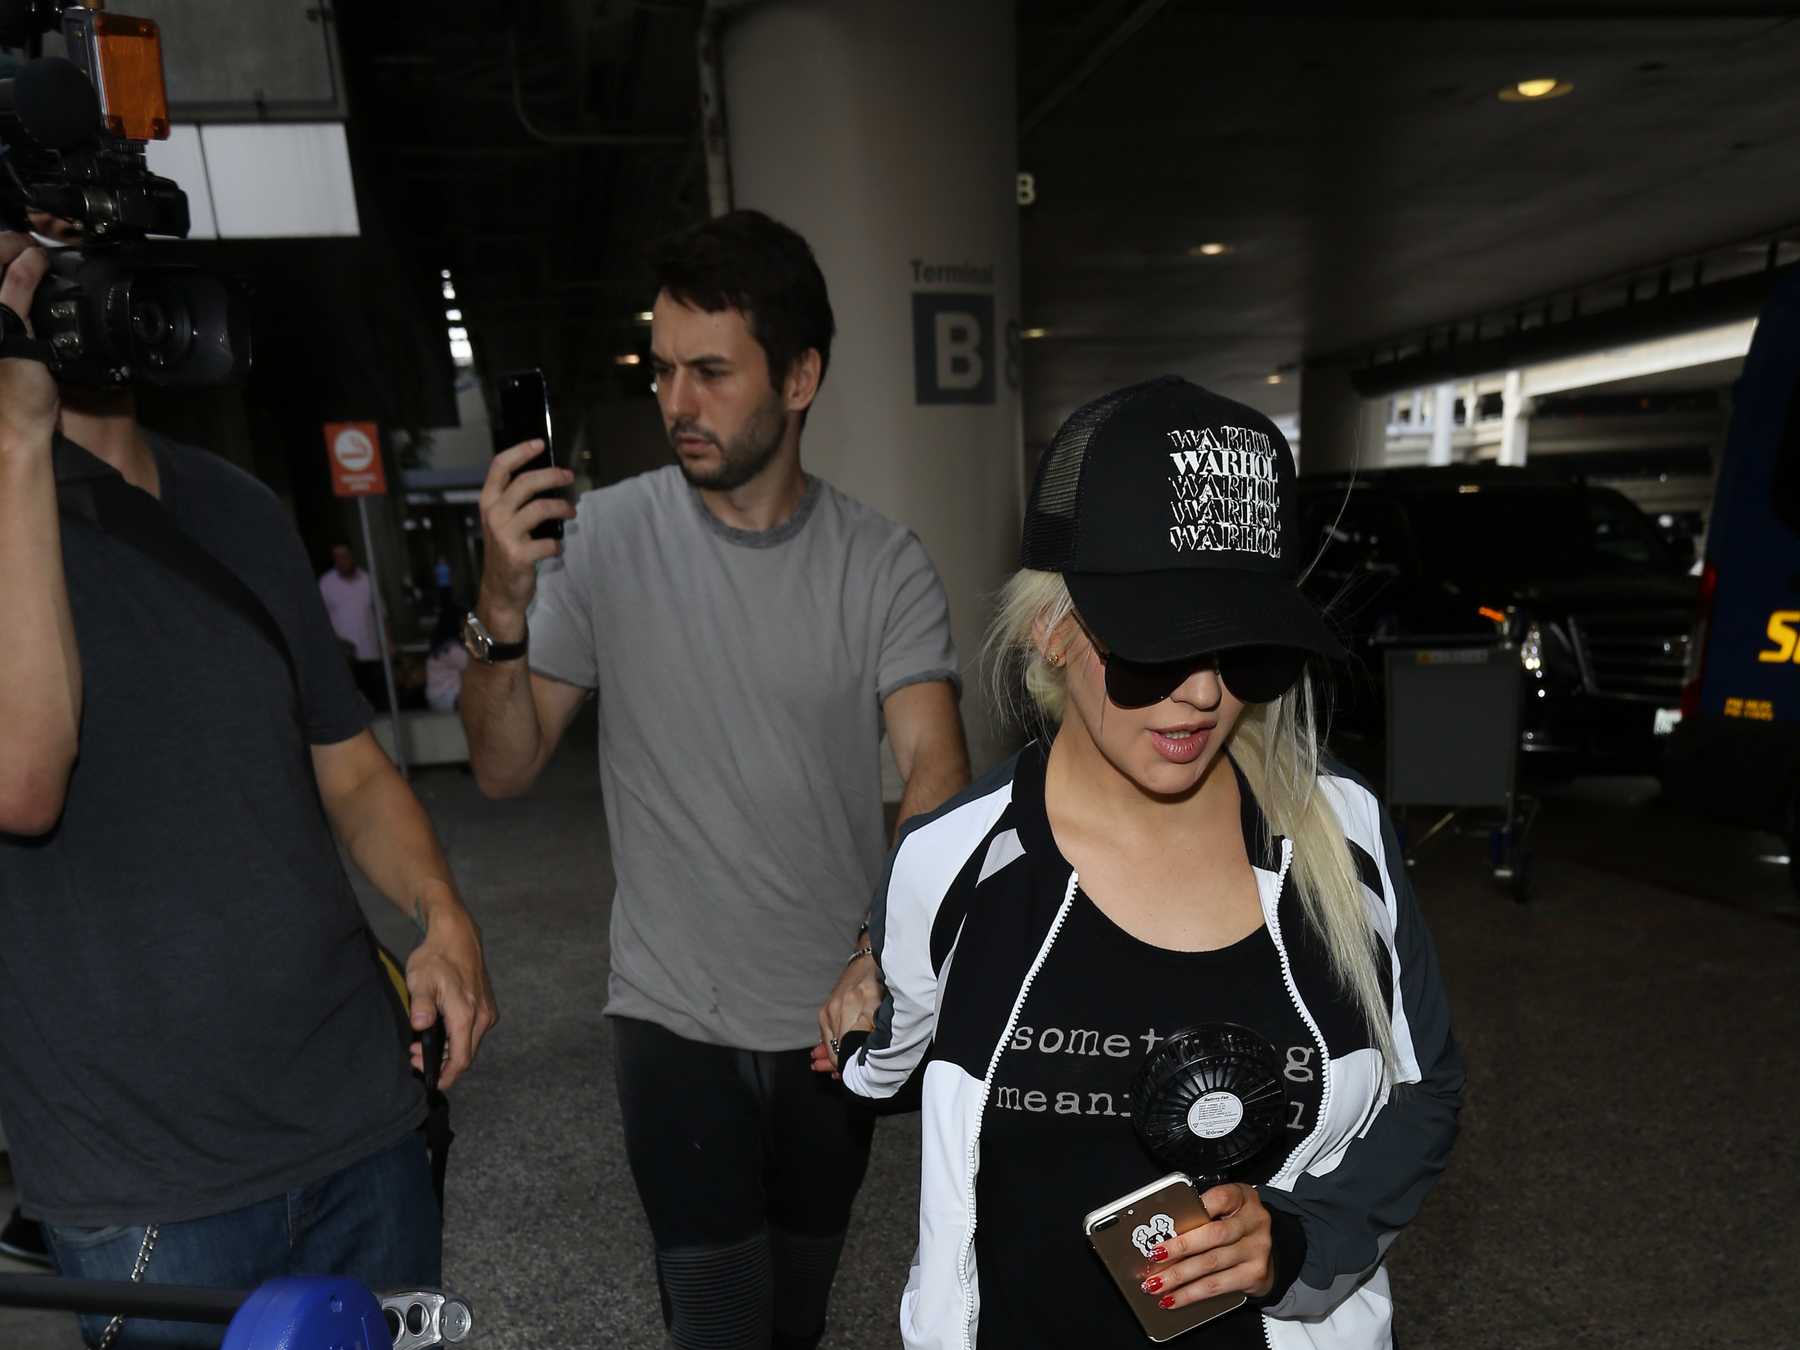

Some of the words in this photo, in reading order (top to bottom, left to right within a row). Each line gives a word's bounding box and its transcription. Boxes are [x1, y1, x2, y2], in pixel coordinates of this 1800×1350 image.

[1016, 173, 1036, 205] B
[910, 259, 995, 285] Terminal
[934, 311, 984, 391] B
[1167, 425, 1277, 459] WARHOL
[1170, 449, 1278, 483] WARHOL
[1168, 473, 1280, 508] WARHOL
[1170, 498, 1281, 532] WARHOL
[1169, 523, 1281, 559] WARHOL
[1759, 610, 1800, 664] S
